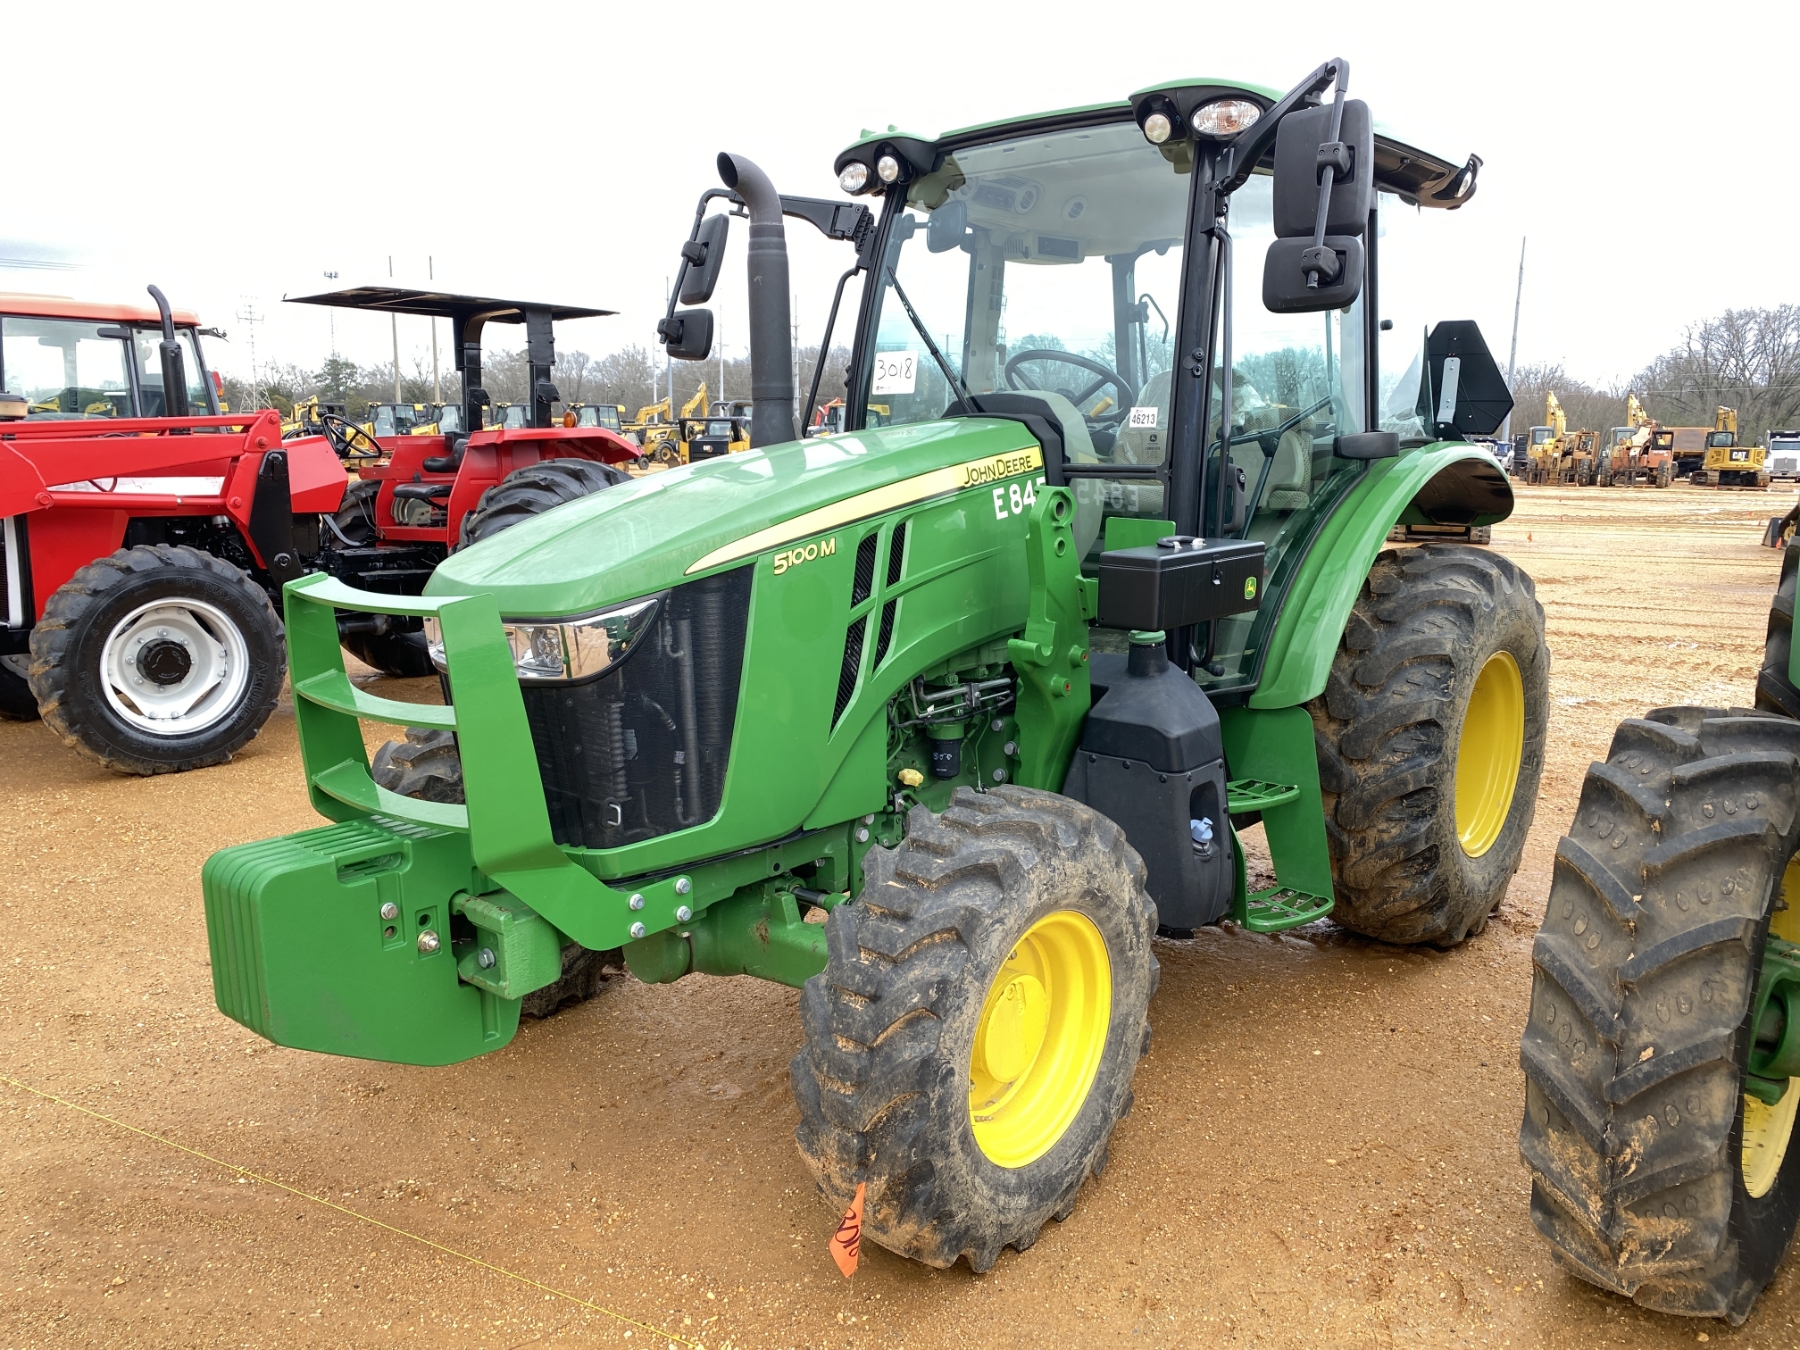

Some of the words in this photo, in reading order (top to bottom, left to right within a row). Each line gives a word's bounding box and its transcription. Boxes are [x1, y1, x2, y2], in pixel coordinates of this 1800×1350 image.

[877, 357, 912, 380] 3018
[1131, 413, 1156, 425] 46213
[1732, 451, 1748, 461] CAT
